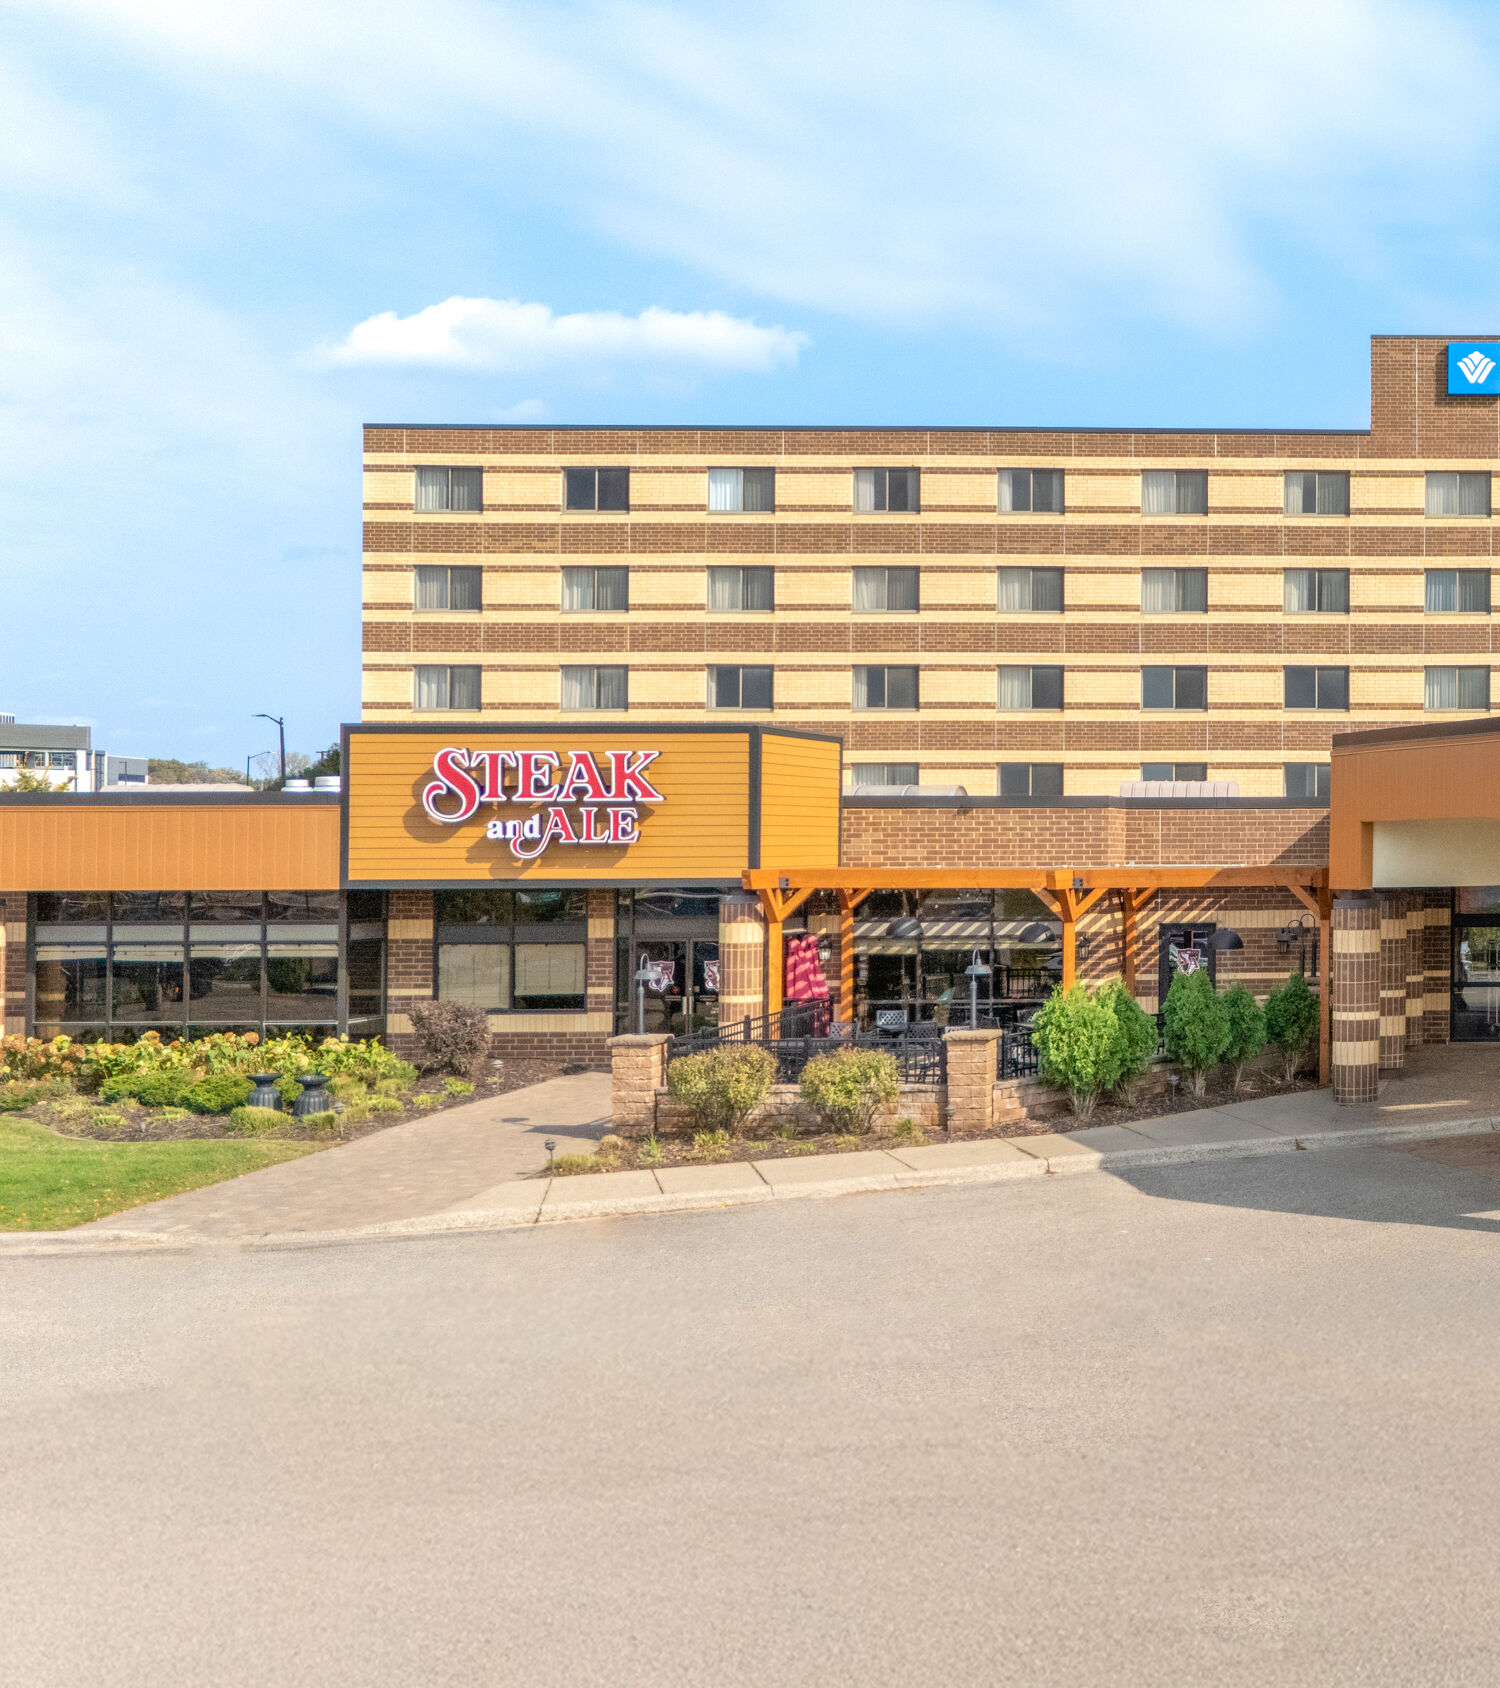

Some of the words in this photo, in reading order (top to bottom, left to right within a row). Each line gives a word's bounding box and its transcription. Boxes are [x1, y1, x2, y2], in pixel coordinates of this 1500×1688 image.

[422, 747, 665, 822] STEAK
[486, 813, 541, 840] and
[510, 807, 640, 859] ALE
